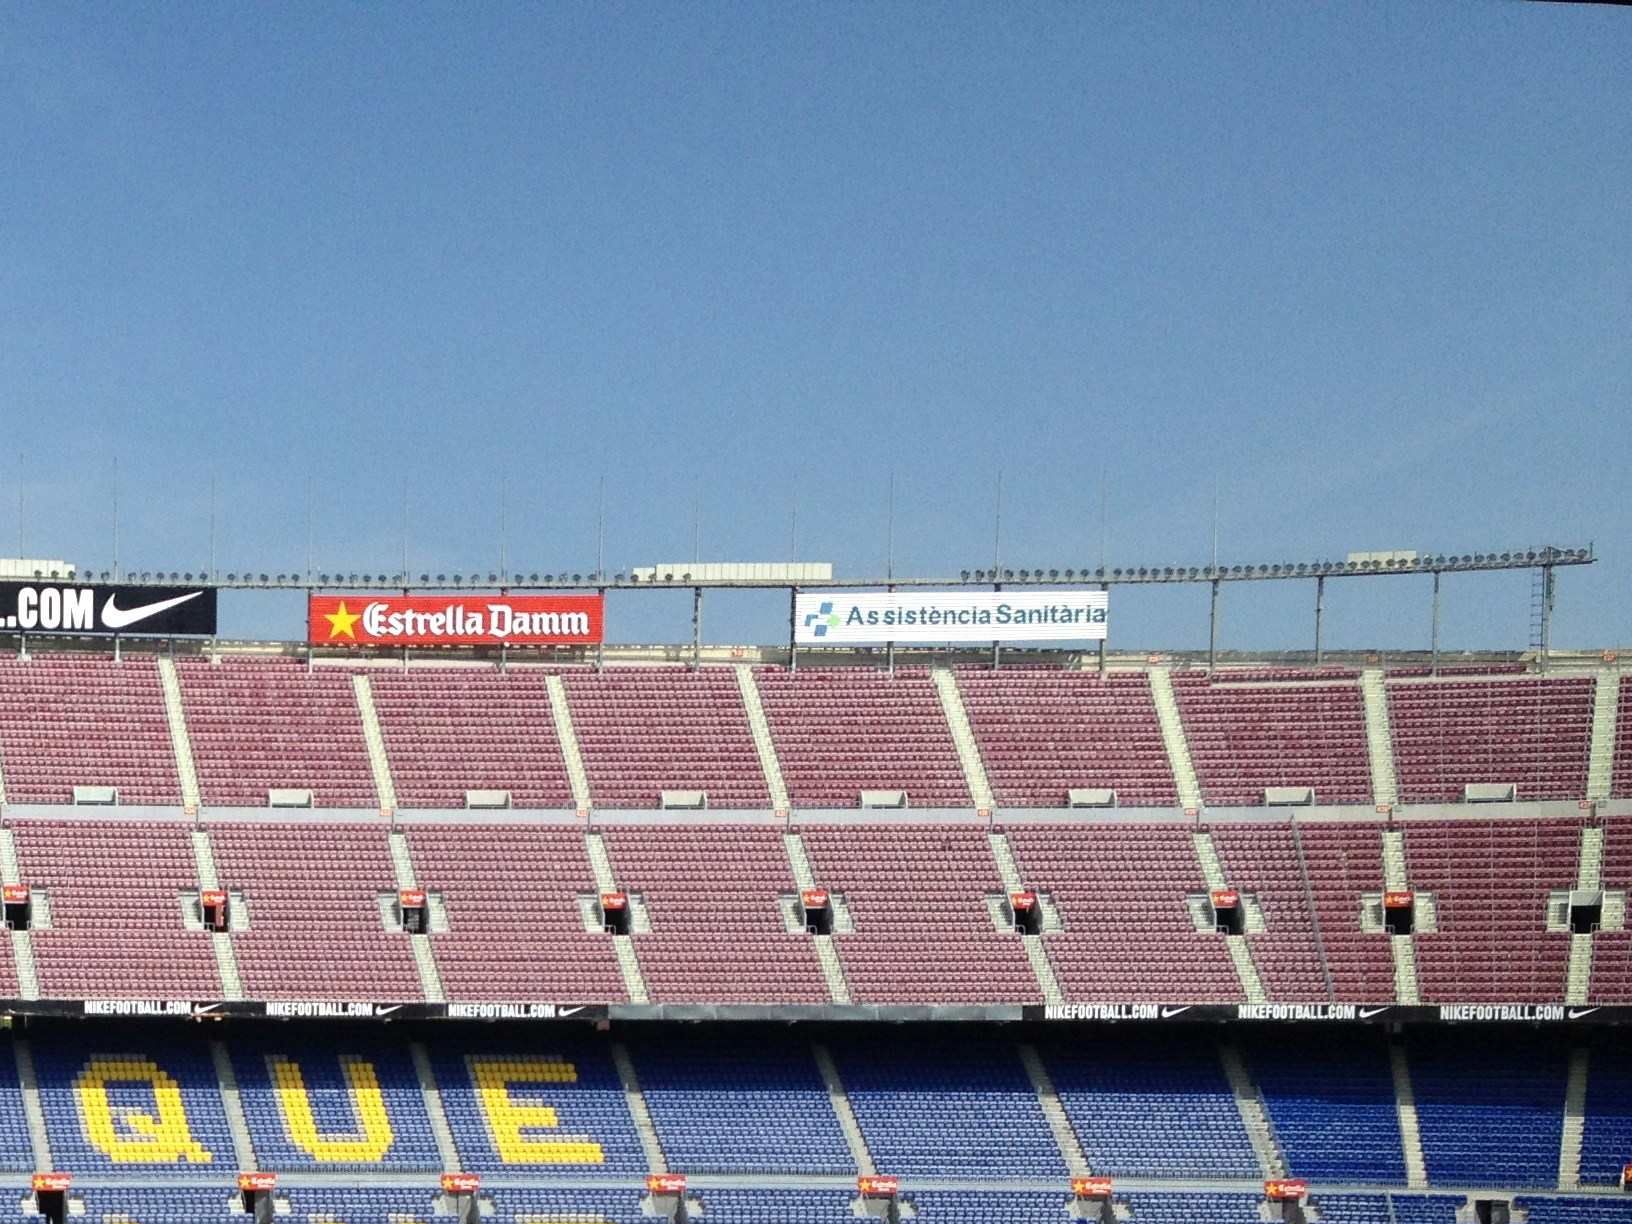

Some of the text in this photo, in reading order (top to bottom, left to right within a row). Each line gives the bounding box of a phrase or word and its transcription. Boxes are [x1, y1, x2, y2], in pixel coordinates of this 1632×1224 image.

[361, 601, 590, 637] Estrella Damm
[845, 603, 1107, 626] Assistència Sanitària
[84, 1001, 192, 1015] NIKEFOOTBALL.COM
[265, 1002, 372, 1016] NIKEFOOTBALL.COM
[448, 1004, 556, 1018] NIKEFOOTBALL.COM
[1045, 1005, 1158, 1020] NIKEFOOTBALL.COM
[1238, 1005, 1355, 1020] NIKEFOOTBALL.COM
[1440, 1005, 1564, 1020] NIKEFOOTBALL.COM
[76, 1058, 604, 1164] QUE
